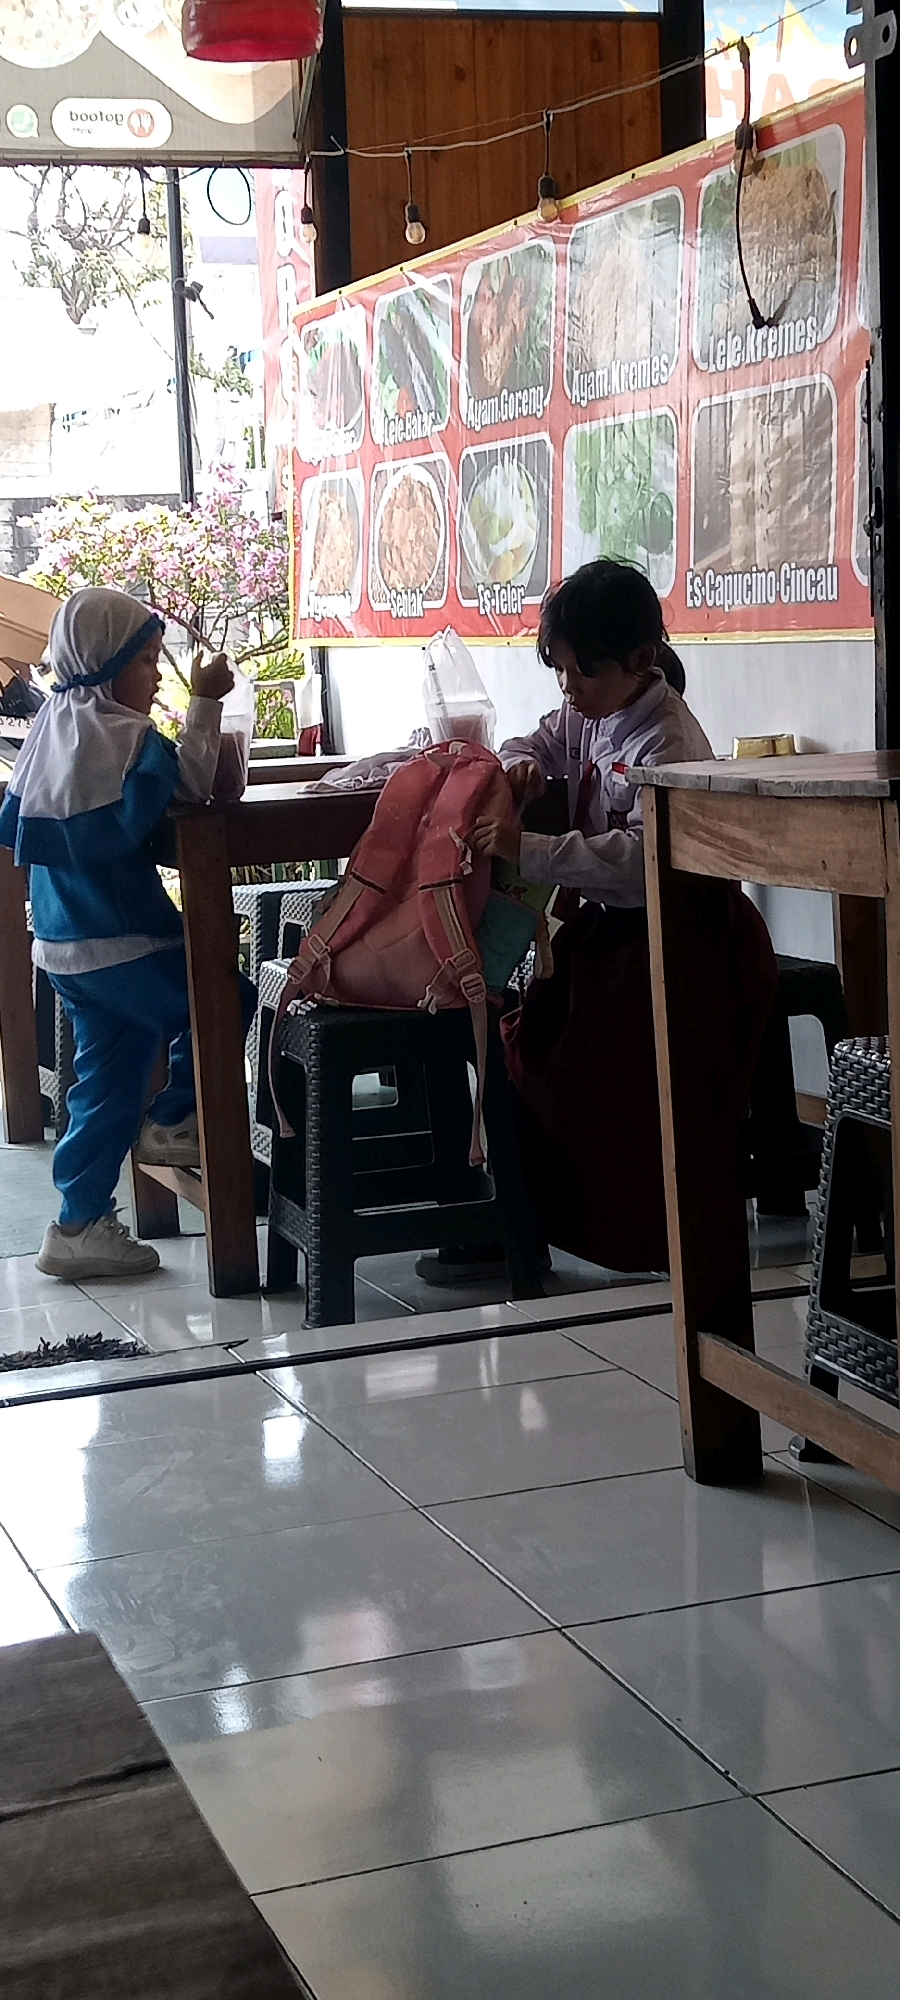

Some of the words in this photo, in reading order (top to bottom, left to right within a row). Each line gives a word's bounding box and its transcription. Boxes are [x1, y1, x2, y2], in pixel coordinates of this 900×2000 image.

[708, 329, 742, 373] Lele
[745, 315, 818, 364] Kremes
[467, 396, 499, 433] Ayam
[501, 384, 543, 422] Goreng
[572, 368, 608, 407] Ayam
[390, 588, 424, 618] Seblak
[477, 583, 491, 615] Es
[493, 580, 525, 615] Teler
[686, 570, 702, 608] Es
[705, 565, 776, 612] Capucino
[780, 562, 839, 603] Cincau
